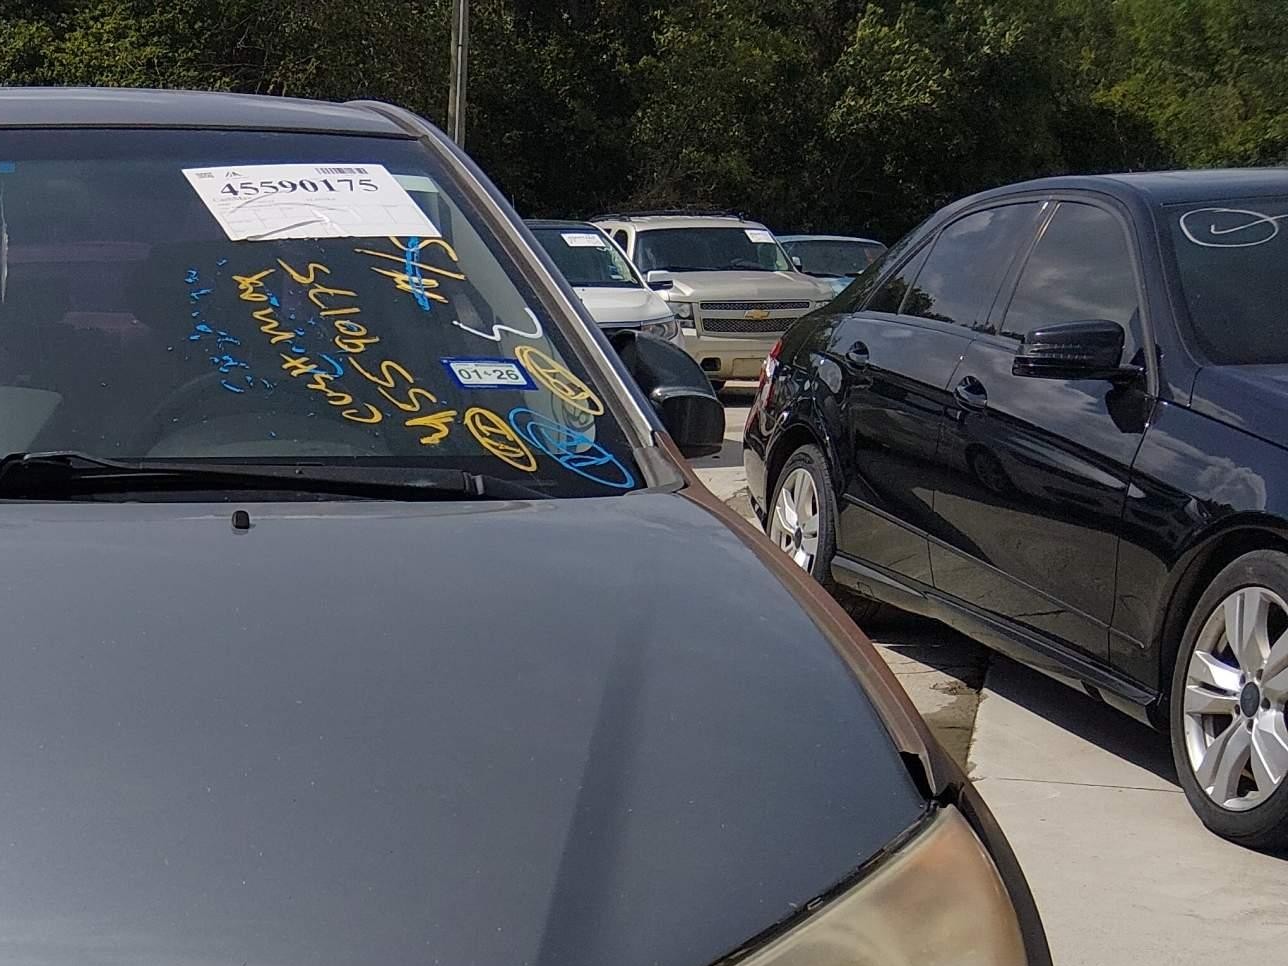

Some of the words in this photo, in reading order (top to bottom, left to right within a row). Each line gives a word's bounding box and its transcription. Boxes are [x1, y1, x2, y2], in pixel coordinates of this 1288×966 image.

[220, 177, 378, 197] 45590175
[457, 368, 483, 380] 01
[492, 369, 520, 381] 26
